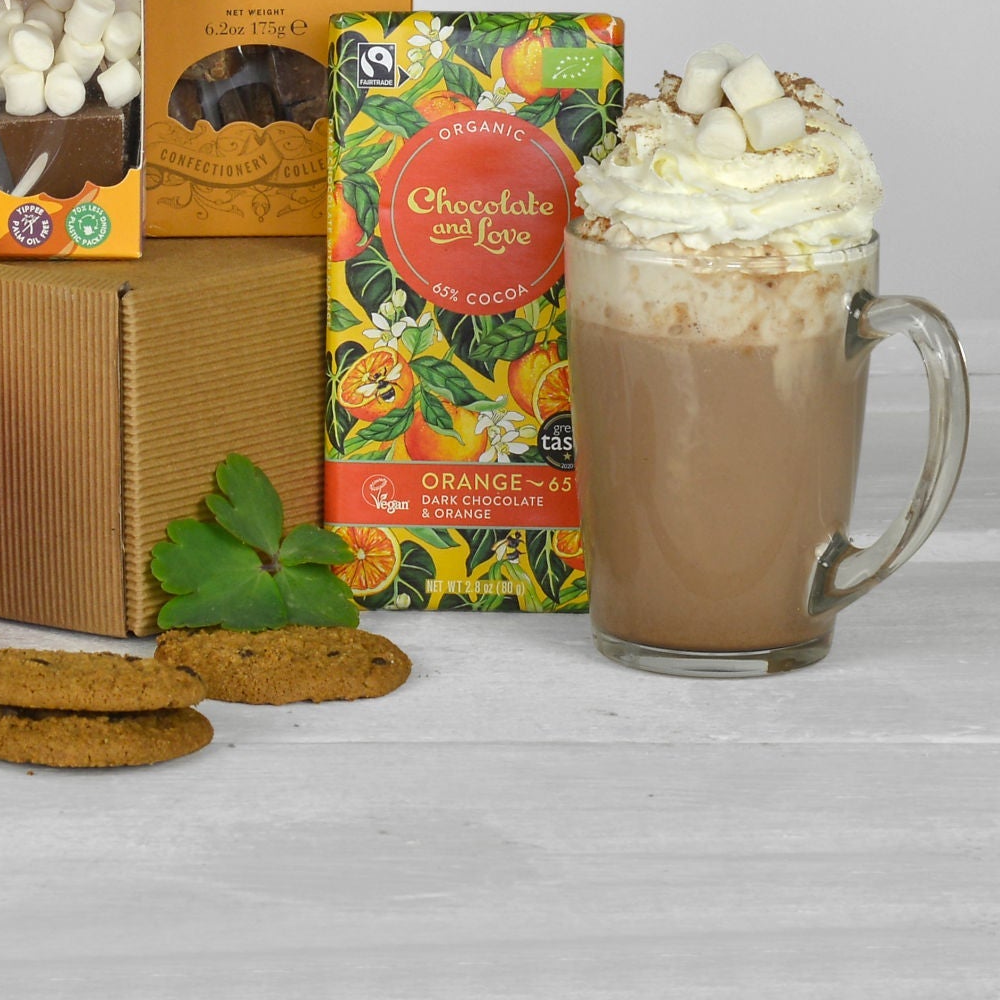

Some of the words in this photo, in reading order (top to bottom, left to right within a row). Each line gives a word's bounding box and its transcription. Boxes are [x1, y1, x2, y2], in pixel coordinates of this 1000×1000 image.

[248, 8, 285, 16] WEIGHT
[205, 22, 245, 36] 6.2oz
[251, 21, 286, 39] 175g
[439, 120, 525, 142] ORGANIC
[160, 148, 267, 177] CONFECTIONERY
[284, 160, 326, 178] COLLE
[88, 205, 104, 215] LESS
[407, 186, 554, 216] Chocolate
[16, 205, 44, 216] YIPPEE
[12, 220, 25, 243] PALM
[26, 237, 40, 245] OIL
[40, 219, 49, 239] FREE
[432, 218, 473, 237] and
[474, 216, 532, 255] Love
[432, 282, 459, 302] 65%
[466, 283, 528, 305] COCOA
[553, 424, 572, 436] gre
[541, 433, 574, 451] tas
[421, 472, 522, 492] ORANGE
[548, 476, 576, 492] 65
[370, 493, 409, 514] Vegan
[422, 495, 458, 505] DARK
[462, 495, 544, 507] CHOCOLATE
[422, 508, 430, 519] &
[434, 508, 491, 519] ORANGE
[426, 579, 443, 593] NET
[447, 580, 462, 593] WT
[465, 581, 480, 593] 2.8
[483, 584, 493, 594] oz
